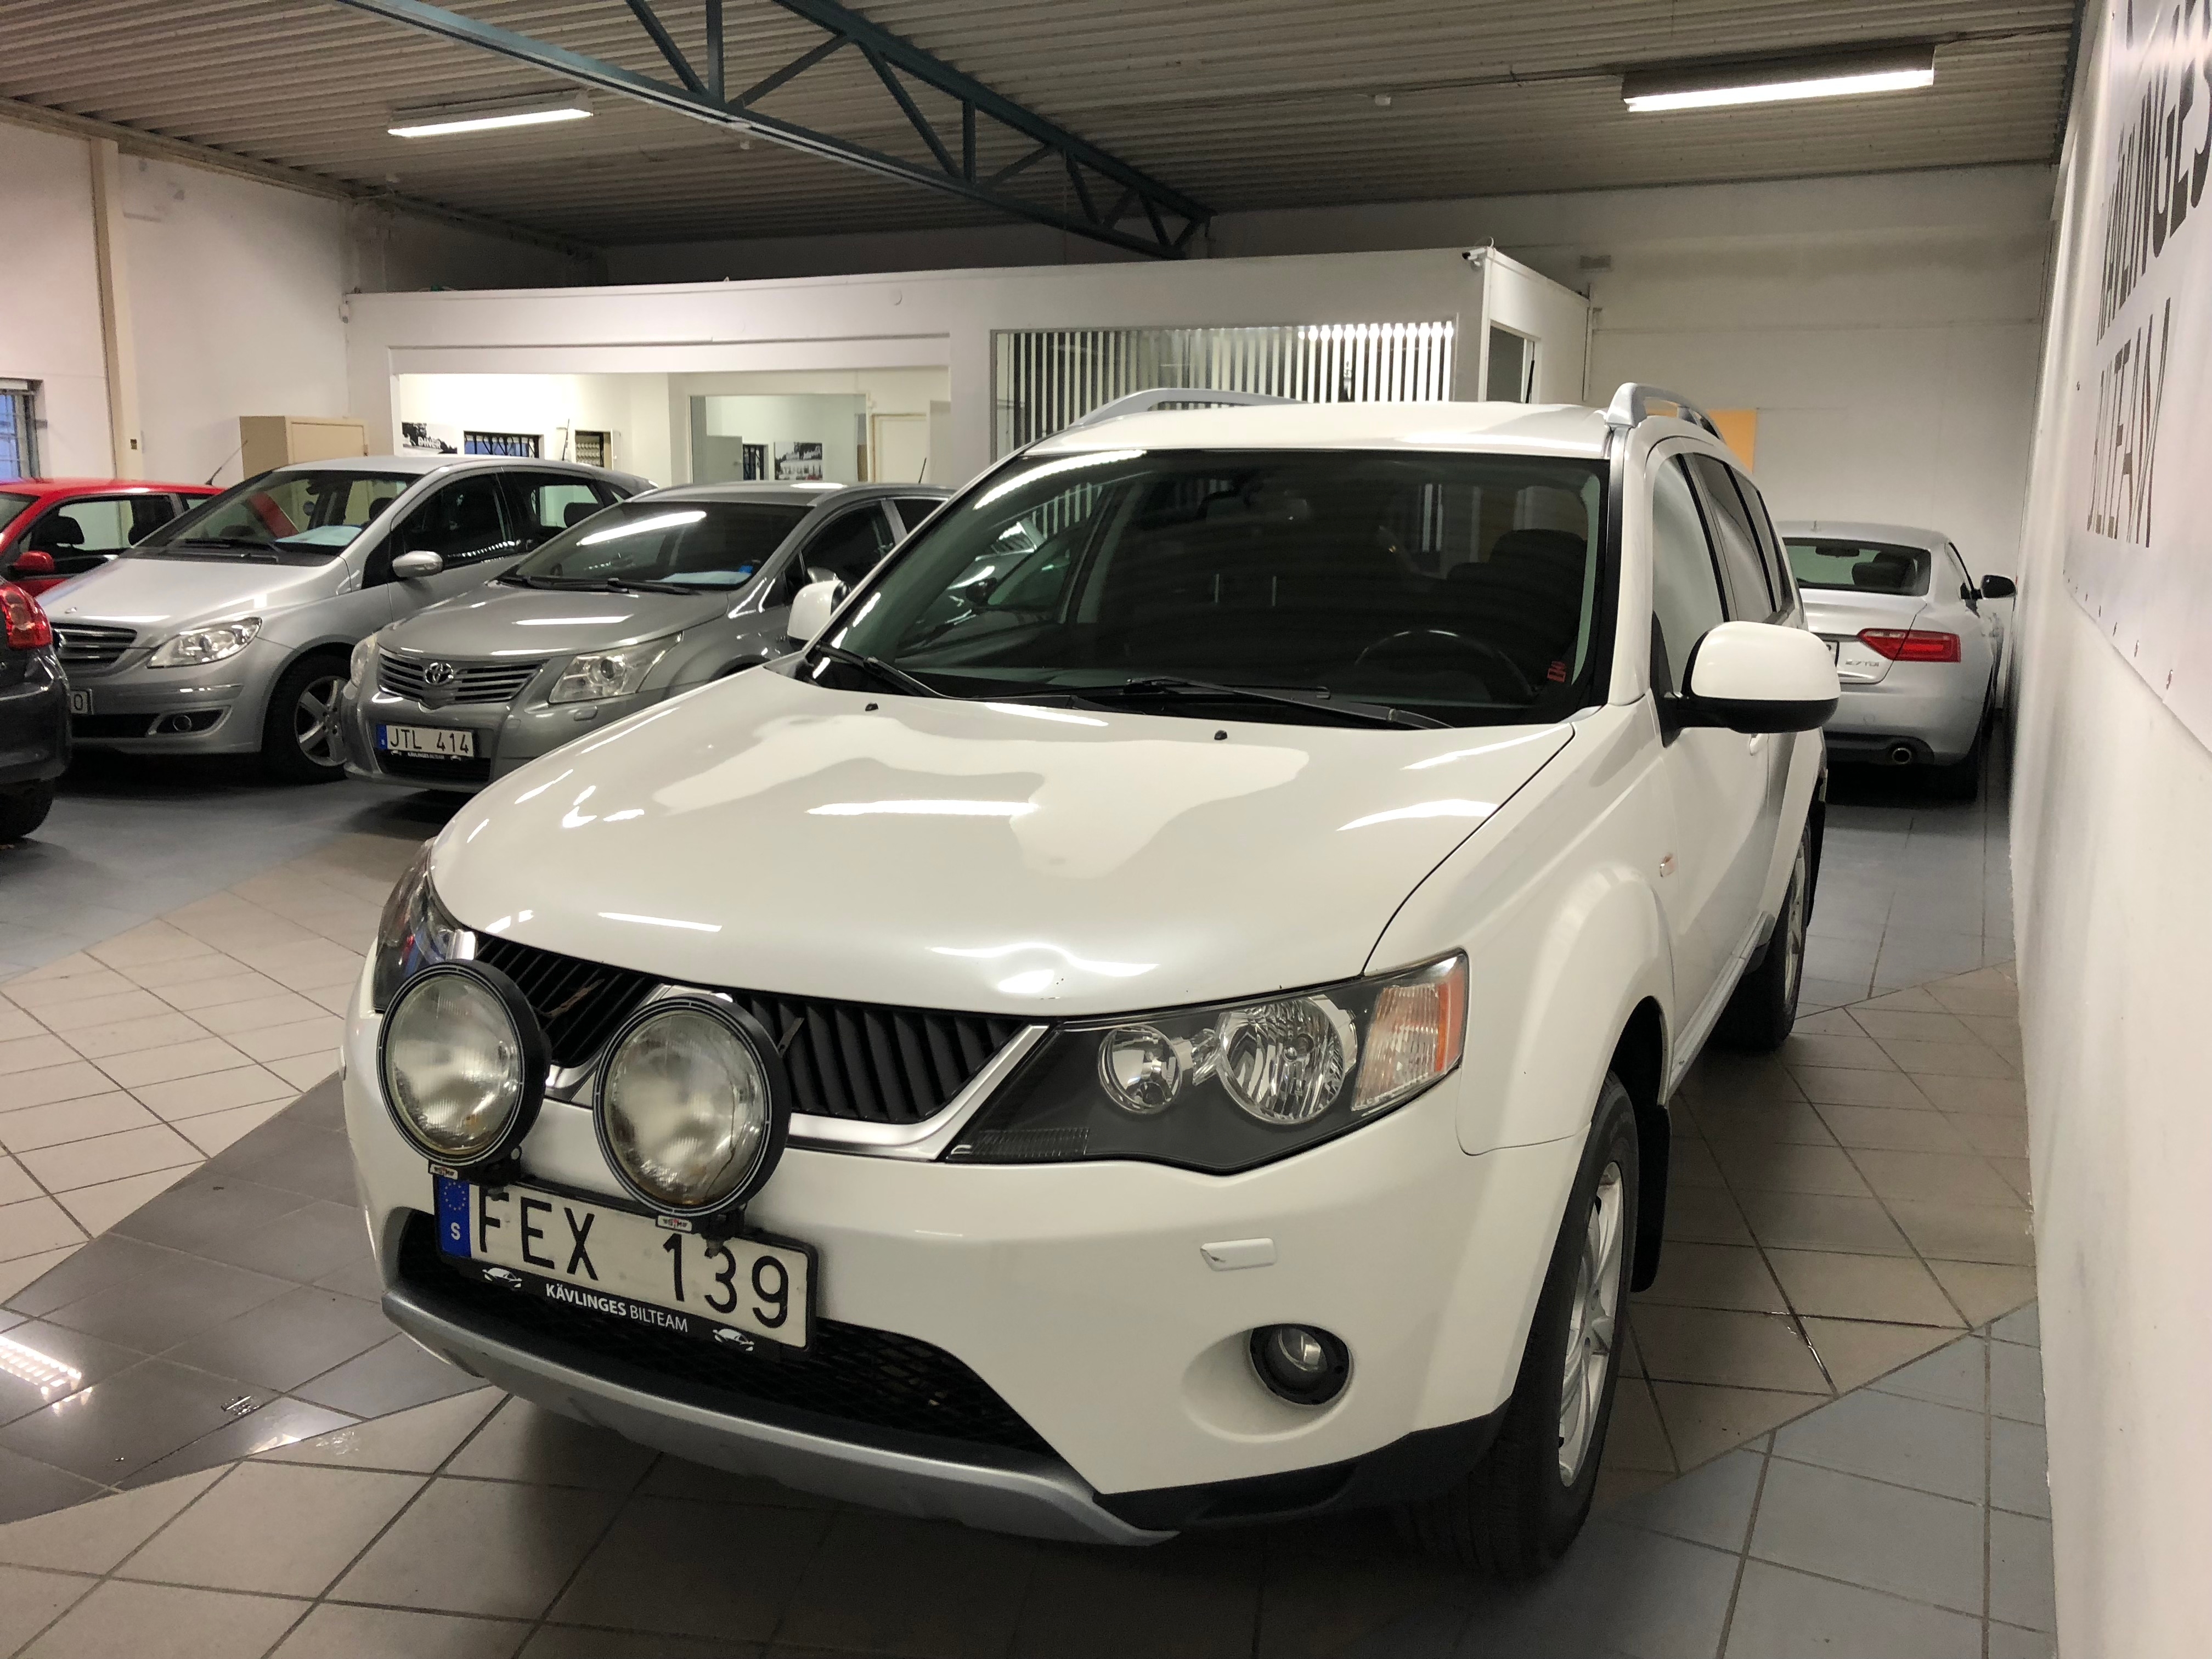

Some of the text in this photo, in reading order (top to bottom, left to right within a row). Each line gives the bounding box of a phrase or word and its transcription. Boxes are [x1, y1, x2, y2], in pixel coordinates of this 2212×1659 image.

[2086, 297, 2171, 548] BILTEAM
[390, 728, 469, 753] JTL 414
[450, 1222, 461, 1240] S
[478, 1185, 789, 1329] FEX 139
[546, 1283, 689, 1333] KÄVLINGES BILTEAM
